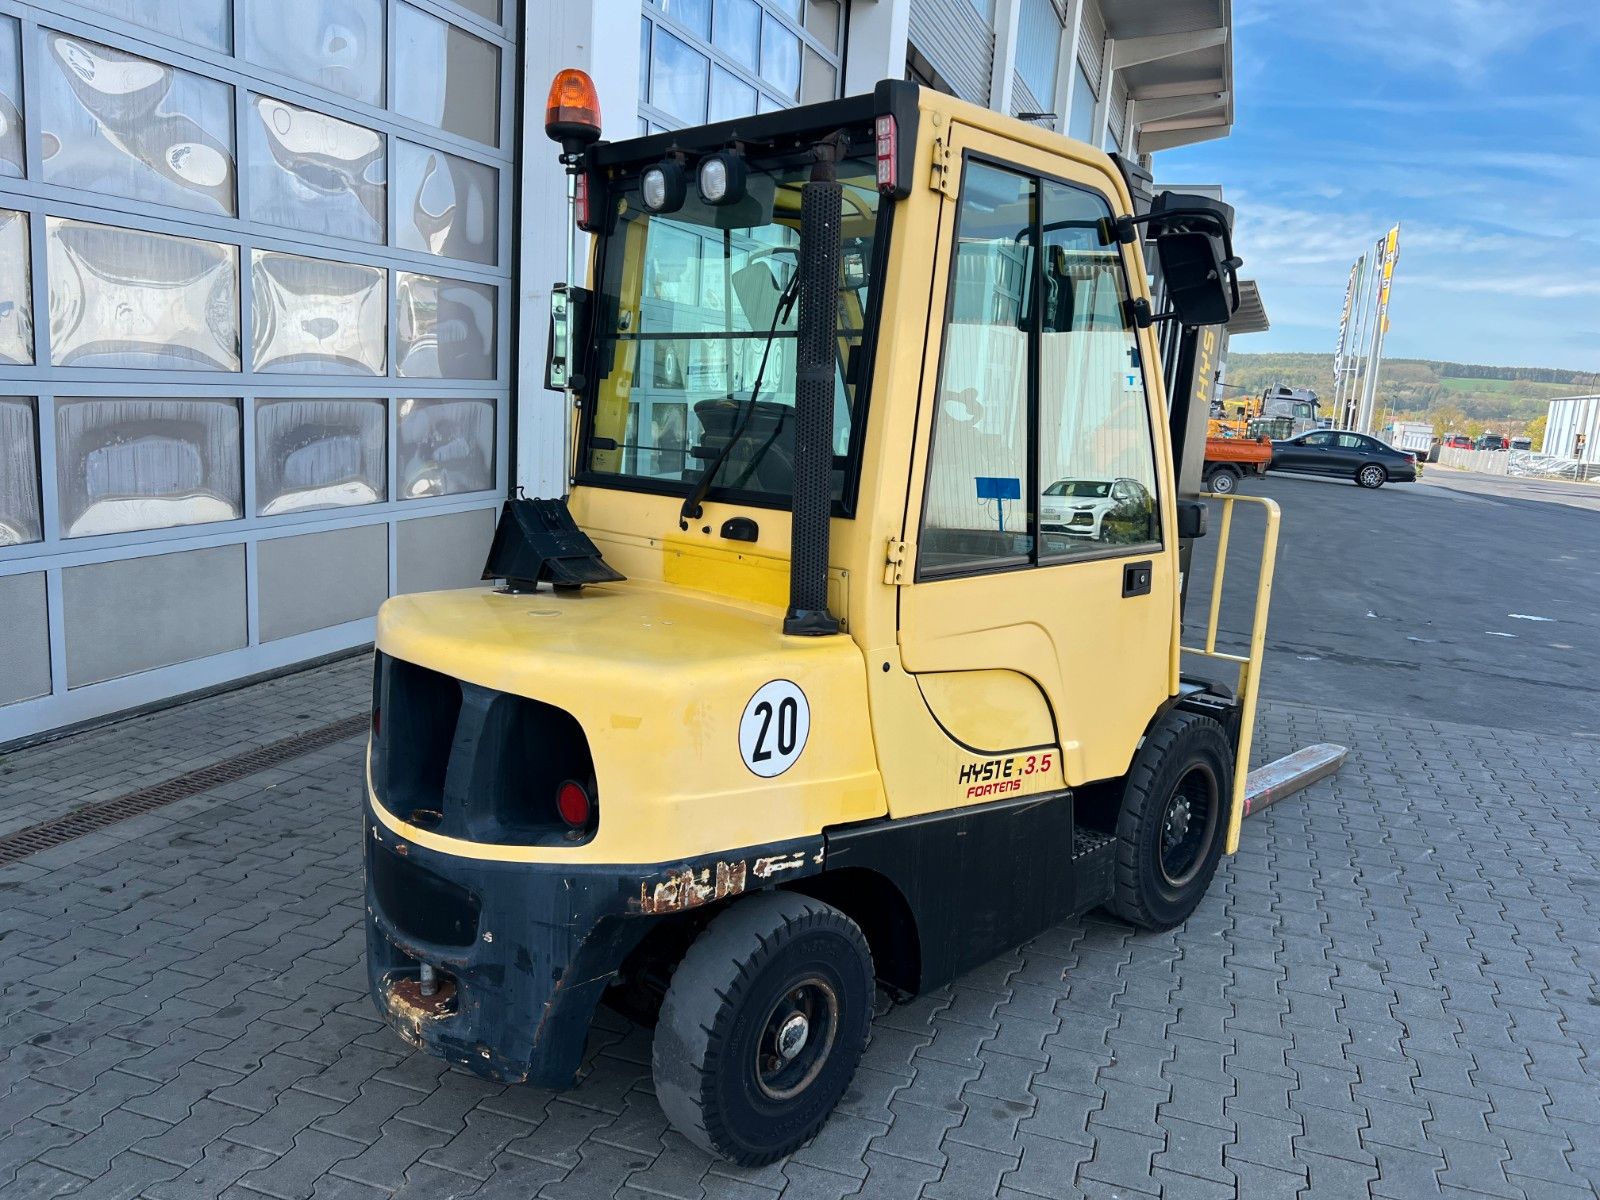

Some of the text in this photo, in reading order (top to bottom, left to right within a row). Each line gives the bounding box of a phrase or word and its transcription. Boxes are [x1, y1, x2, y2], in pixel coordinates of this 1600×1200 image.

[1196, 326, 1214, 402] HYS
[752, 696, 798, 763] 20
[1024, 753, 1052, 775] 3.5
[966, 779, 1022, 798] FORTENS
